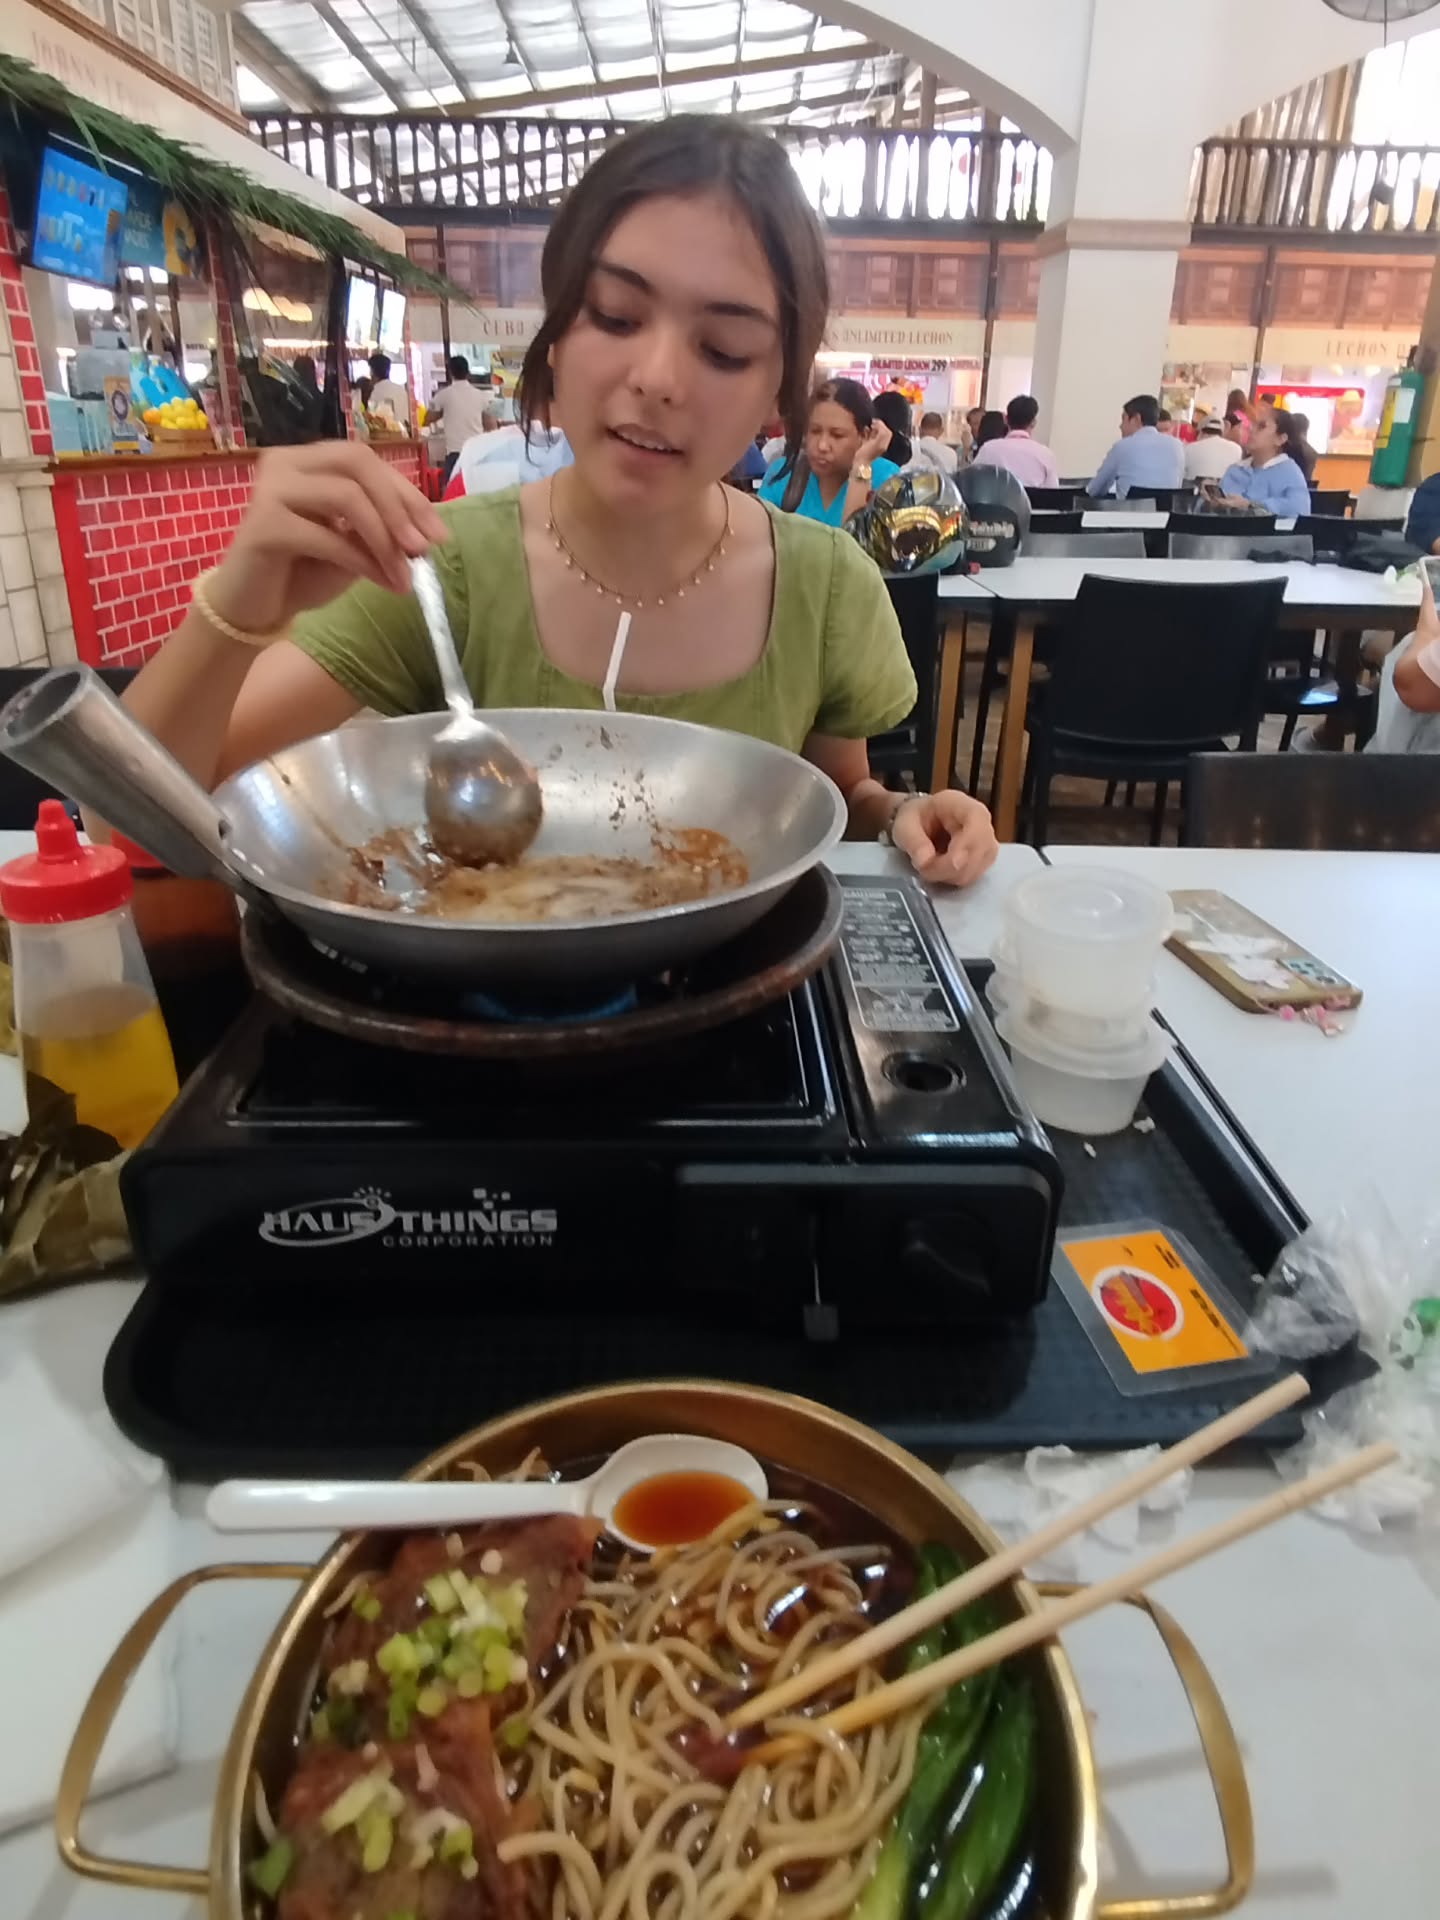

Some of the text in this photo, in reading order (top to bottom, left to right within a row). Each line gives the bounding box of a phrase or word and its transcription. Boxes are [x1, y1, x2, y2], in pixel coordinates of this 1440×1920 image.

[908, 330, 954, 345] LECHON
[1325, 341, 1390, 358] LECHON
[931, 359, 948, 372] 299
[263, 1209, 558, 1236] HAUS THINGS
[382, 1234, 554, 1247] CORPORATION
